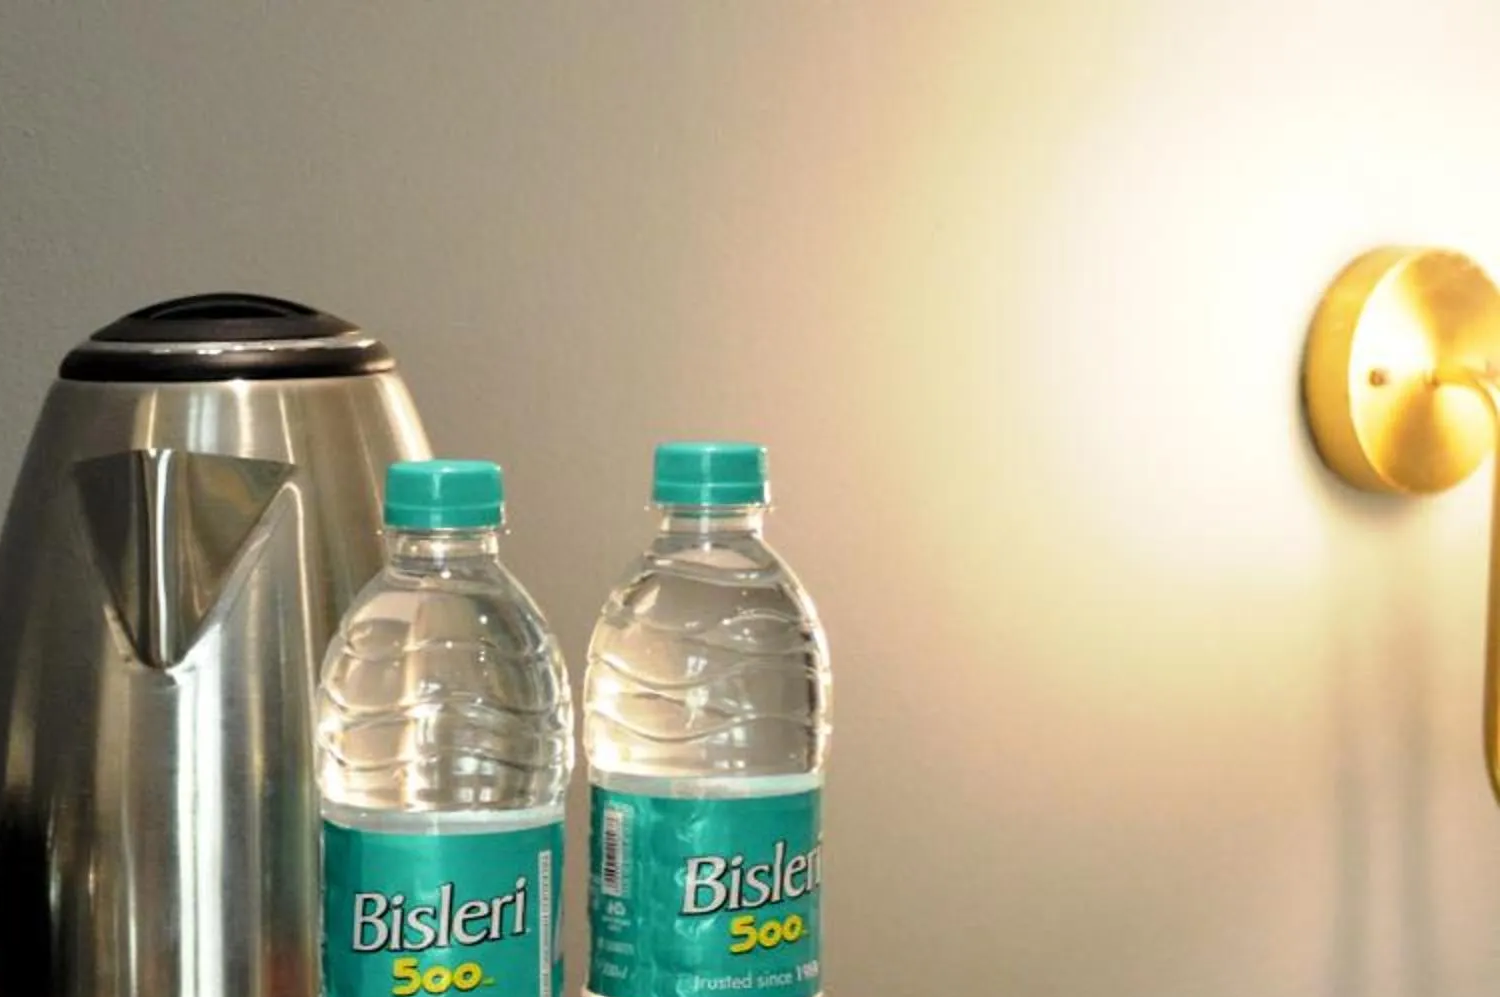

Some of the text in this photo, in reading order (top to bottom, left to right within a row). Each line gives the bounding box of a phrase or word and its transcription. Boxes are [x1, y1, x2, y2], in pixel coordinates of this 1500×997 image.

[351, 876, 529, 953] Bisleri
[728, 913, 804, 953] 500
[391, 956, 485, 997] 500
